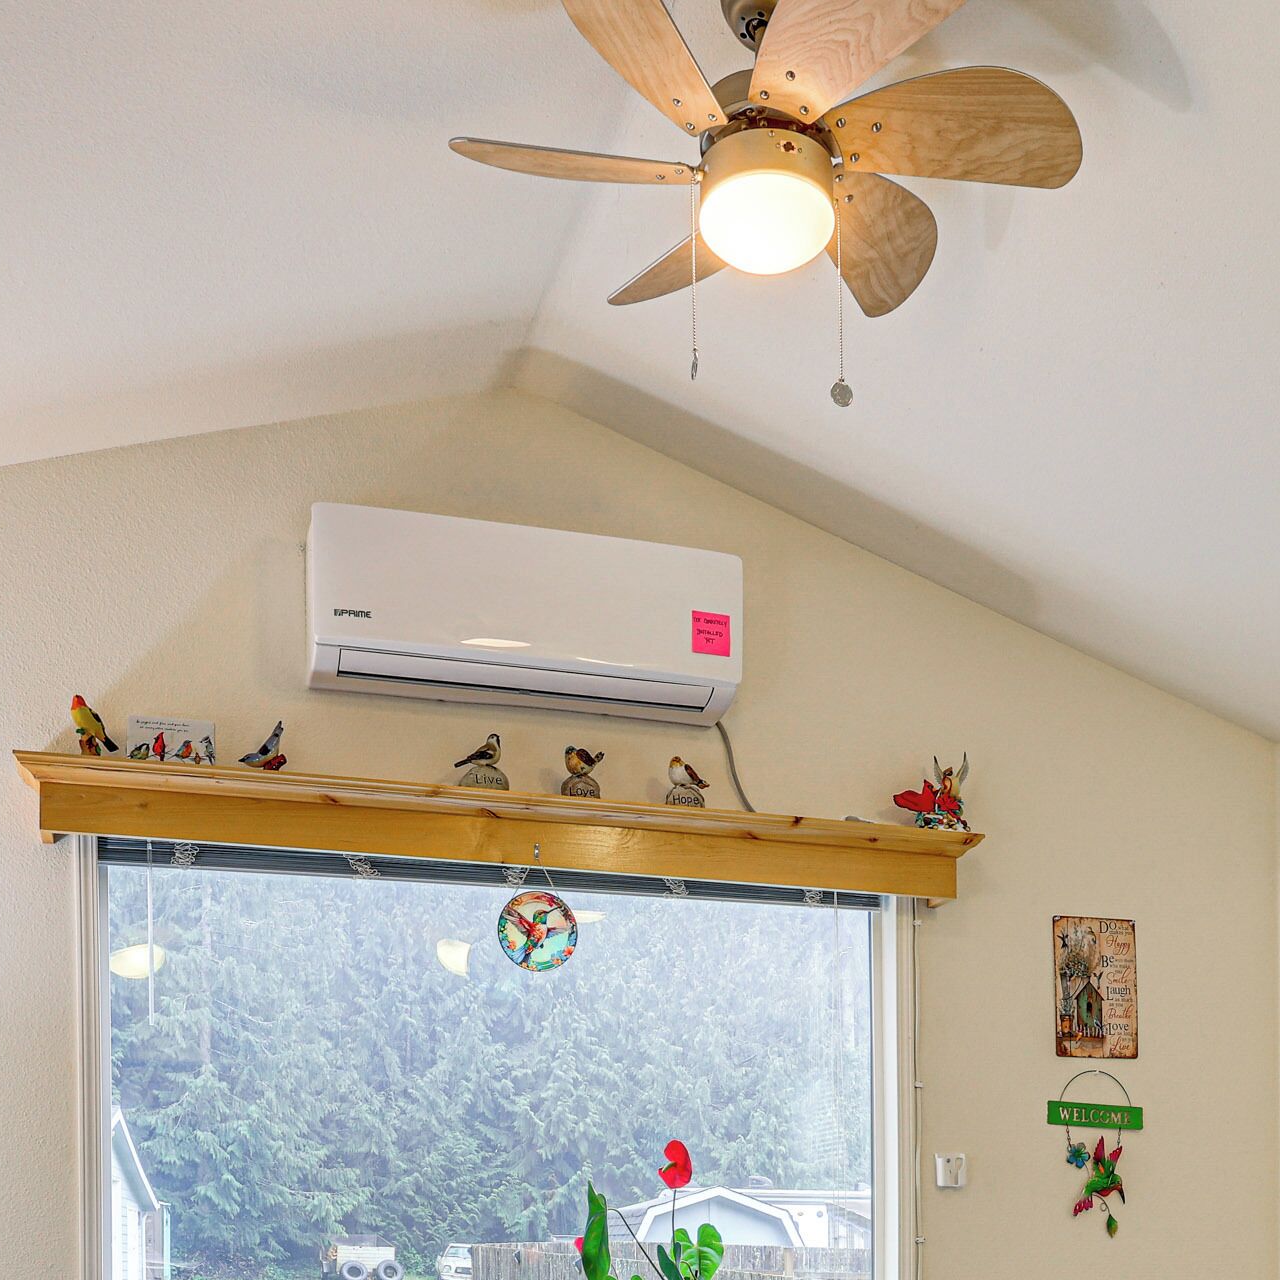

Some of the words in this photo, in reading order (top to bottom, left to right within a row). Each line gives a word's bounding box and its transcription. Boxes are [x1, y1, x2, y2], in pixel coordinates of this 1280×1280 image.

[340, 609, 372, 619] PRIME
[475, 773, 503, 785] Live
[569, 786, 595, 797] Love
[672, 793, 700, 807] Hope
[1099, 920, 1117, 934] Do
[1101, 954, 1115, 968] Be
[1106, 985, 1131, 1001] Laugh
[1108, 1022, 1129, 1036] Love
[1059, 1106, 1131, 1125] WELCOME
